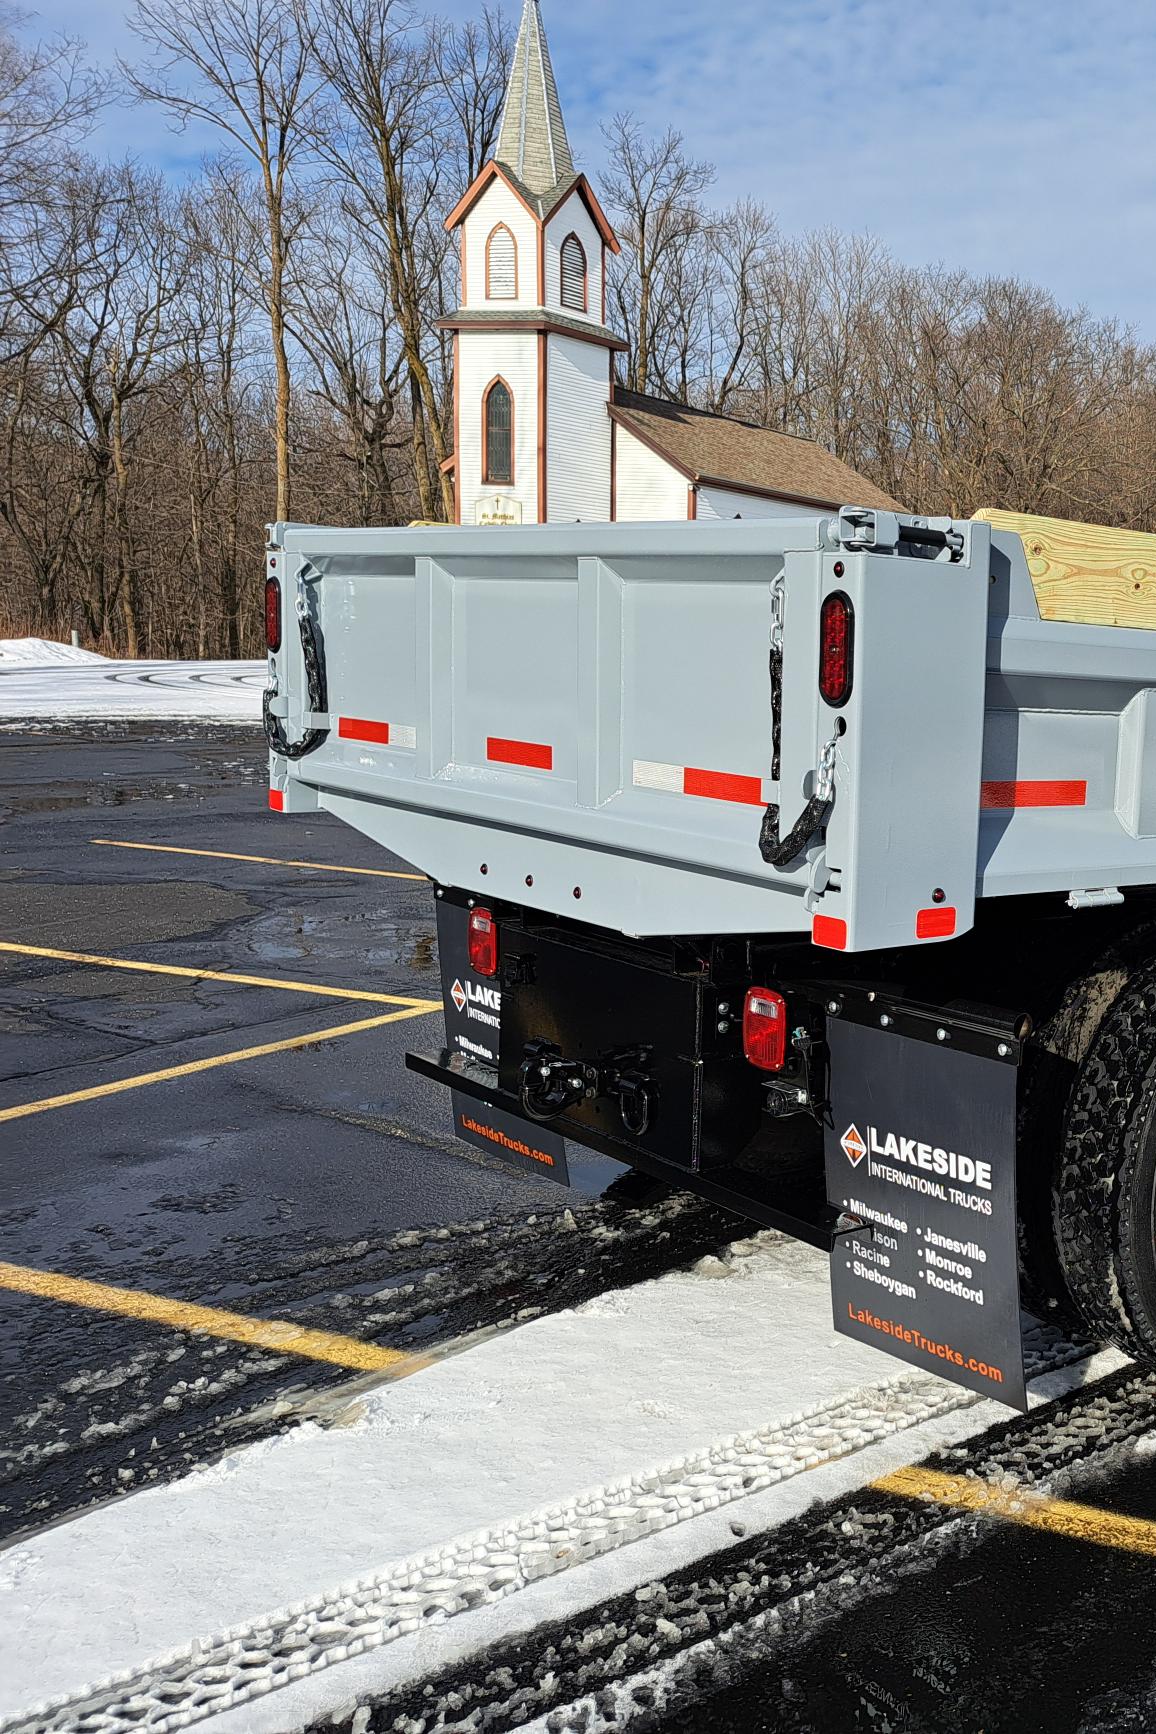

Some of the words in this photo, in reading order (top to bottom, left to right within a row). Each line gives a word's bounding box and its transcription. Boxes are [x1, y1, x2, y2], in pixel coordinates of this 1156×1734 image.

[467, 980, 501, 1011] LAKE
[458, 1034, 493, 1060] Milwaukee
[461, 1113, 555, 1167] LakesideTrucks.com
[870, 1126, 992, 1190] LAKESIDE
[870, 1161, 947, 1202] INTERNATIONAL
[949, 1187, 992, 1216] TRUCKS
[850, 1198, 908, 1234] Milwaukee
[852, 1240, 891, 1268] Racine
[873, 1228, 898, 1251] ison
[923, 1227, 987, 1263] Janesville
[853, 1260, 917, 1300] Sheboygan
[925, 1248, 973, 1279] Monroe
[926, 1269, 984, 1306] Rockford
[848, 1302, 1004, 1384] LakesideTrucks.com
